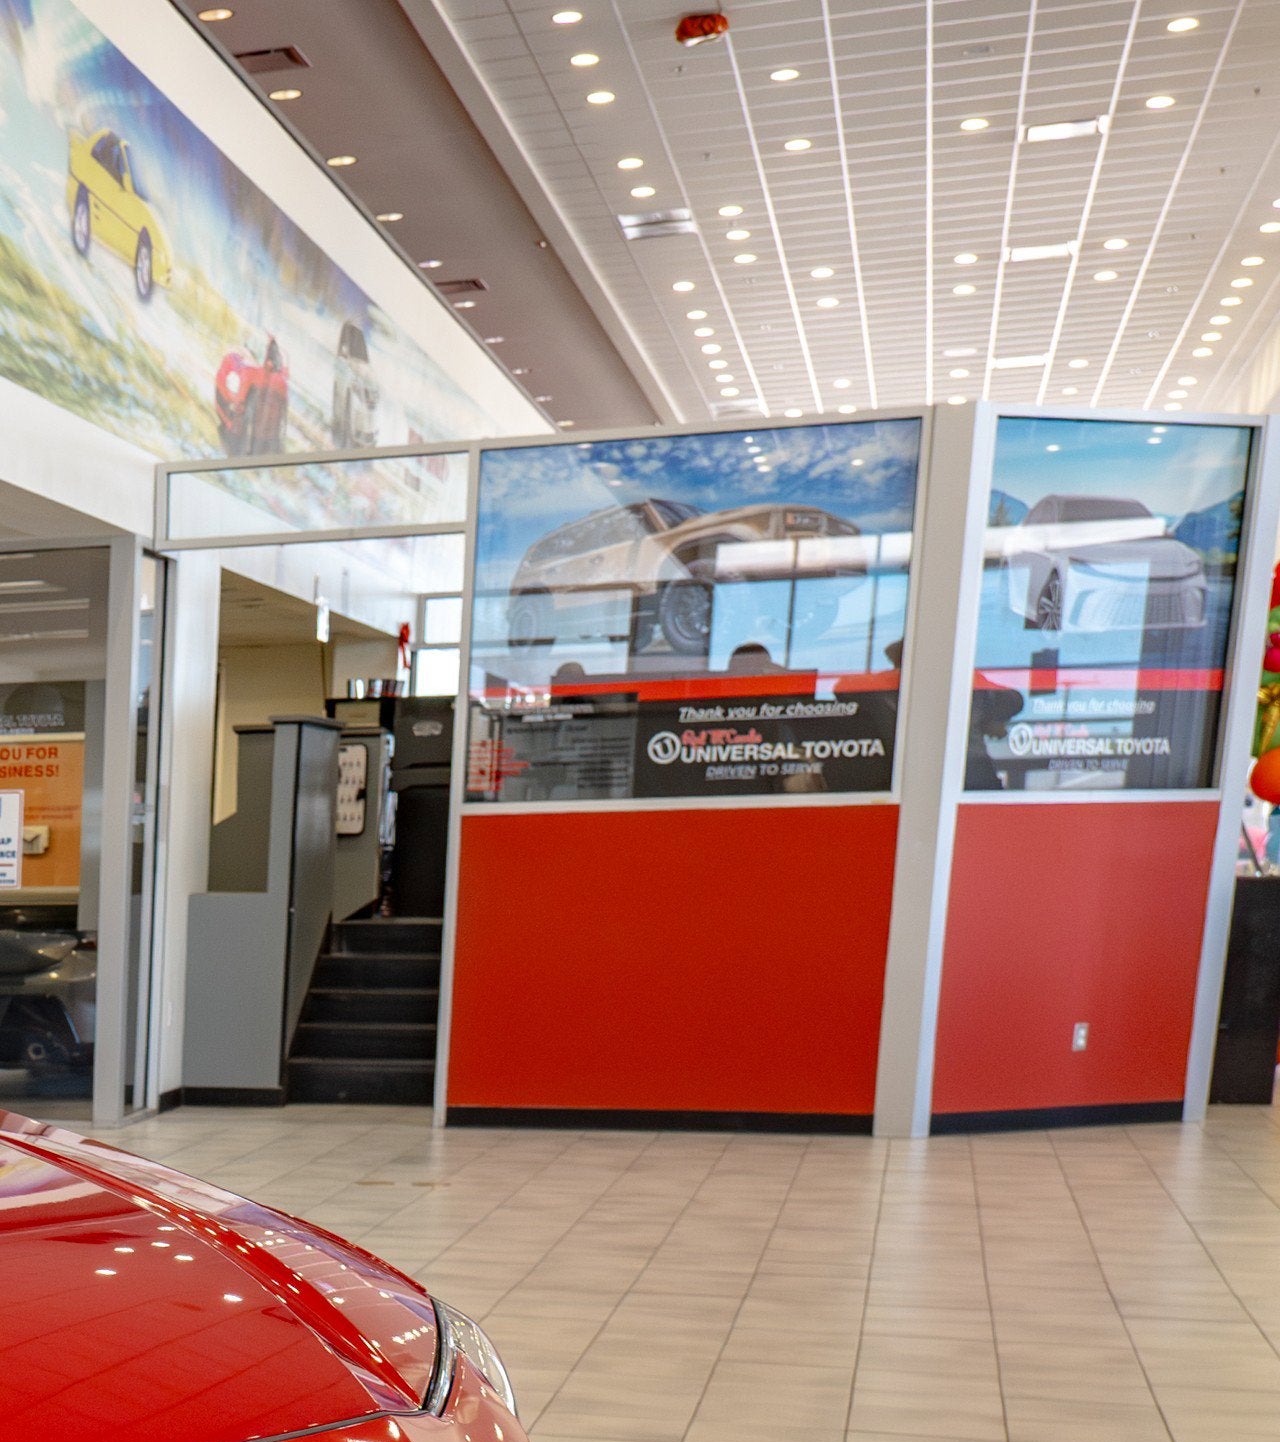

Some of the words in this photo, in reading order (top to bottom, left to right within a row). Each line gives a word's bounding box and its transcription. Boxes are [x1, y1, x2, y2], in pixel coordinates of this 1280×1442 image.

[679, 704, 727, 722] Thank
[727, 704, 758, 721] you
[759, 702, 785, 719] for
[785, 700, 859, 718] choosing
[25, 746, 59, 760] FOR
[681, 742, 800, 763] UNIVERSAL
[802, 739, 885, 758] TOYOTA
[1032, 738, 1114, 756] UNIVERSAL
[1114, 737, 1171, 755] TOYOTA
[759, 763, 779, 776] TO
